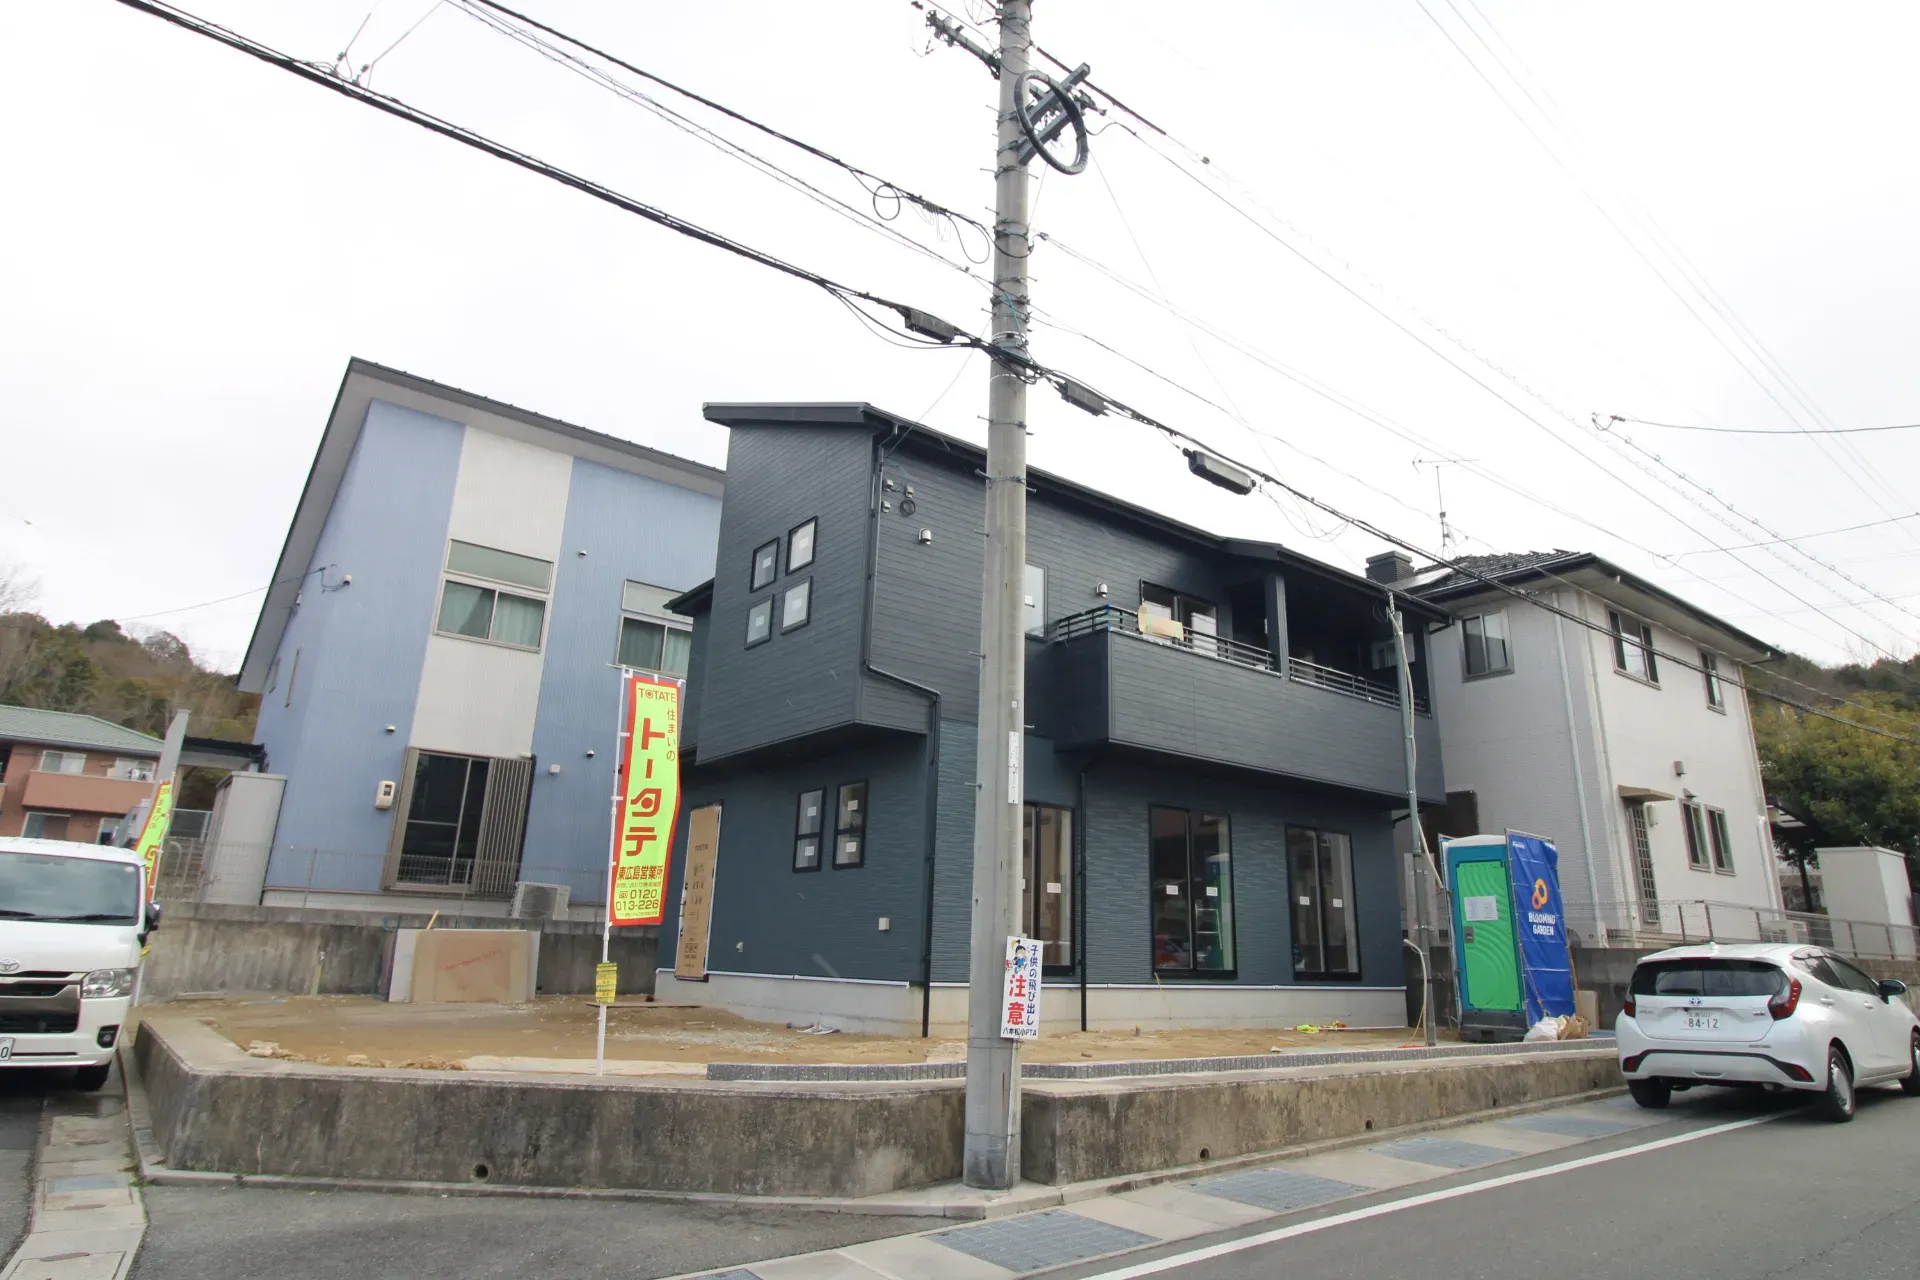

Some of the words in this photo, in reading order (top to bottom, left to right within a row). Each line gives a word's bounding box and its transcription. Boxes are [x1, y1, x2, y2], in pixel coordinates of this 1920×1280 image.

[638, 687, 676, 703] TOTATE
[666, 708, 676, 762] 住まいの
[625, 717, 665, 857] トータテ
[617, 865, 663, 880] 東広島営業所
[630, 889, 658, 899] 0120
[615, 899, 660, 911] 013-226
[1528, 912, 1556, 925] BLOOMING
[1532, 924, 1554, 936] GARDEN
[1027, 945, 1038, 1025] 子供の飛び出し
[1008, 974, 1026, 1025] 注意
[1688, 1018, 1719, 1029] 84-12
